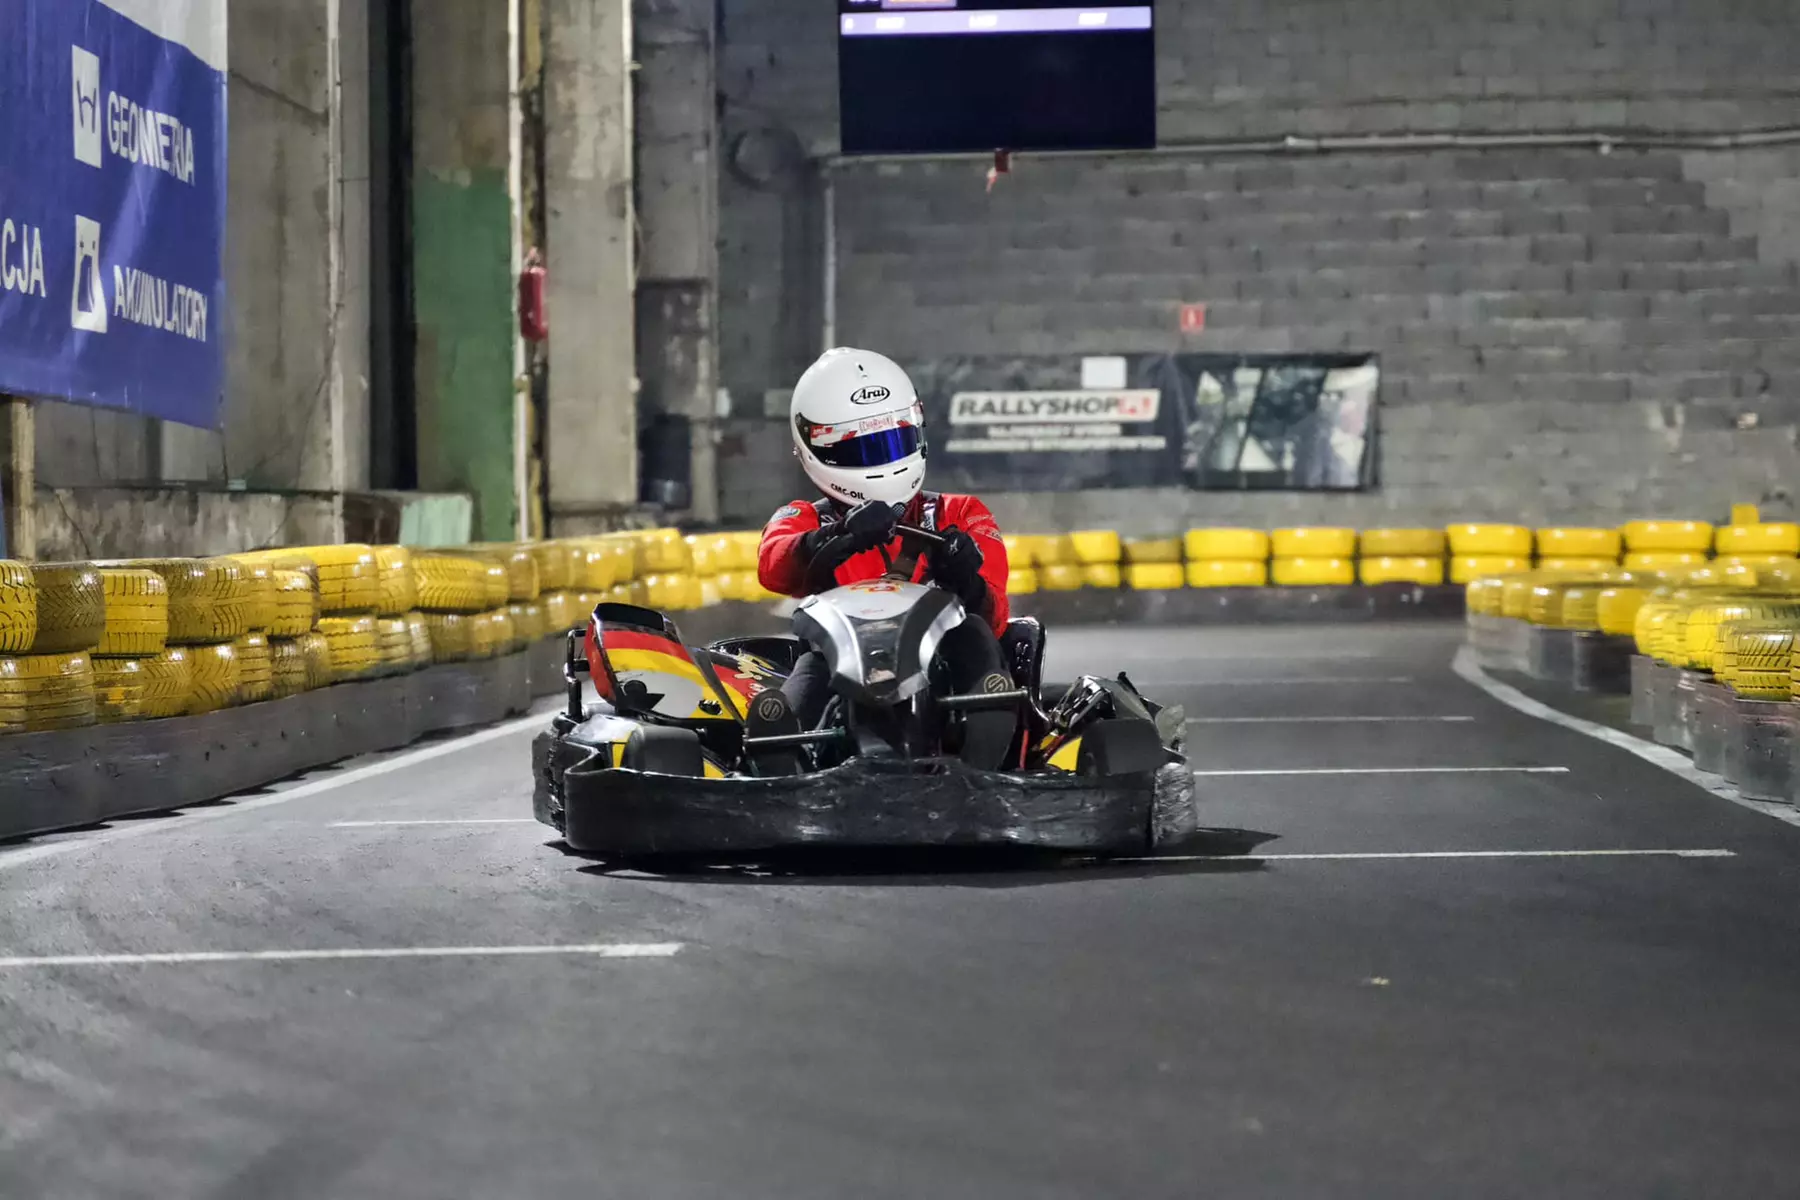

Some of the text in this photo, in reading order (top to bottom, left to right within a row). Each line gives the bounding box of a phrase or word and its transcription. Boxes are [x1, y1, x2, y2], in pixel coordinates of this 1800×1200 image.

[0, 217, 46, 298] CJA
[113, 264, 208, 342] AKUMULATORY
[854, 387, 885, 402] Arai
